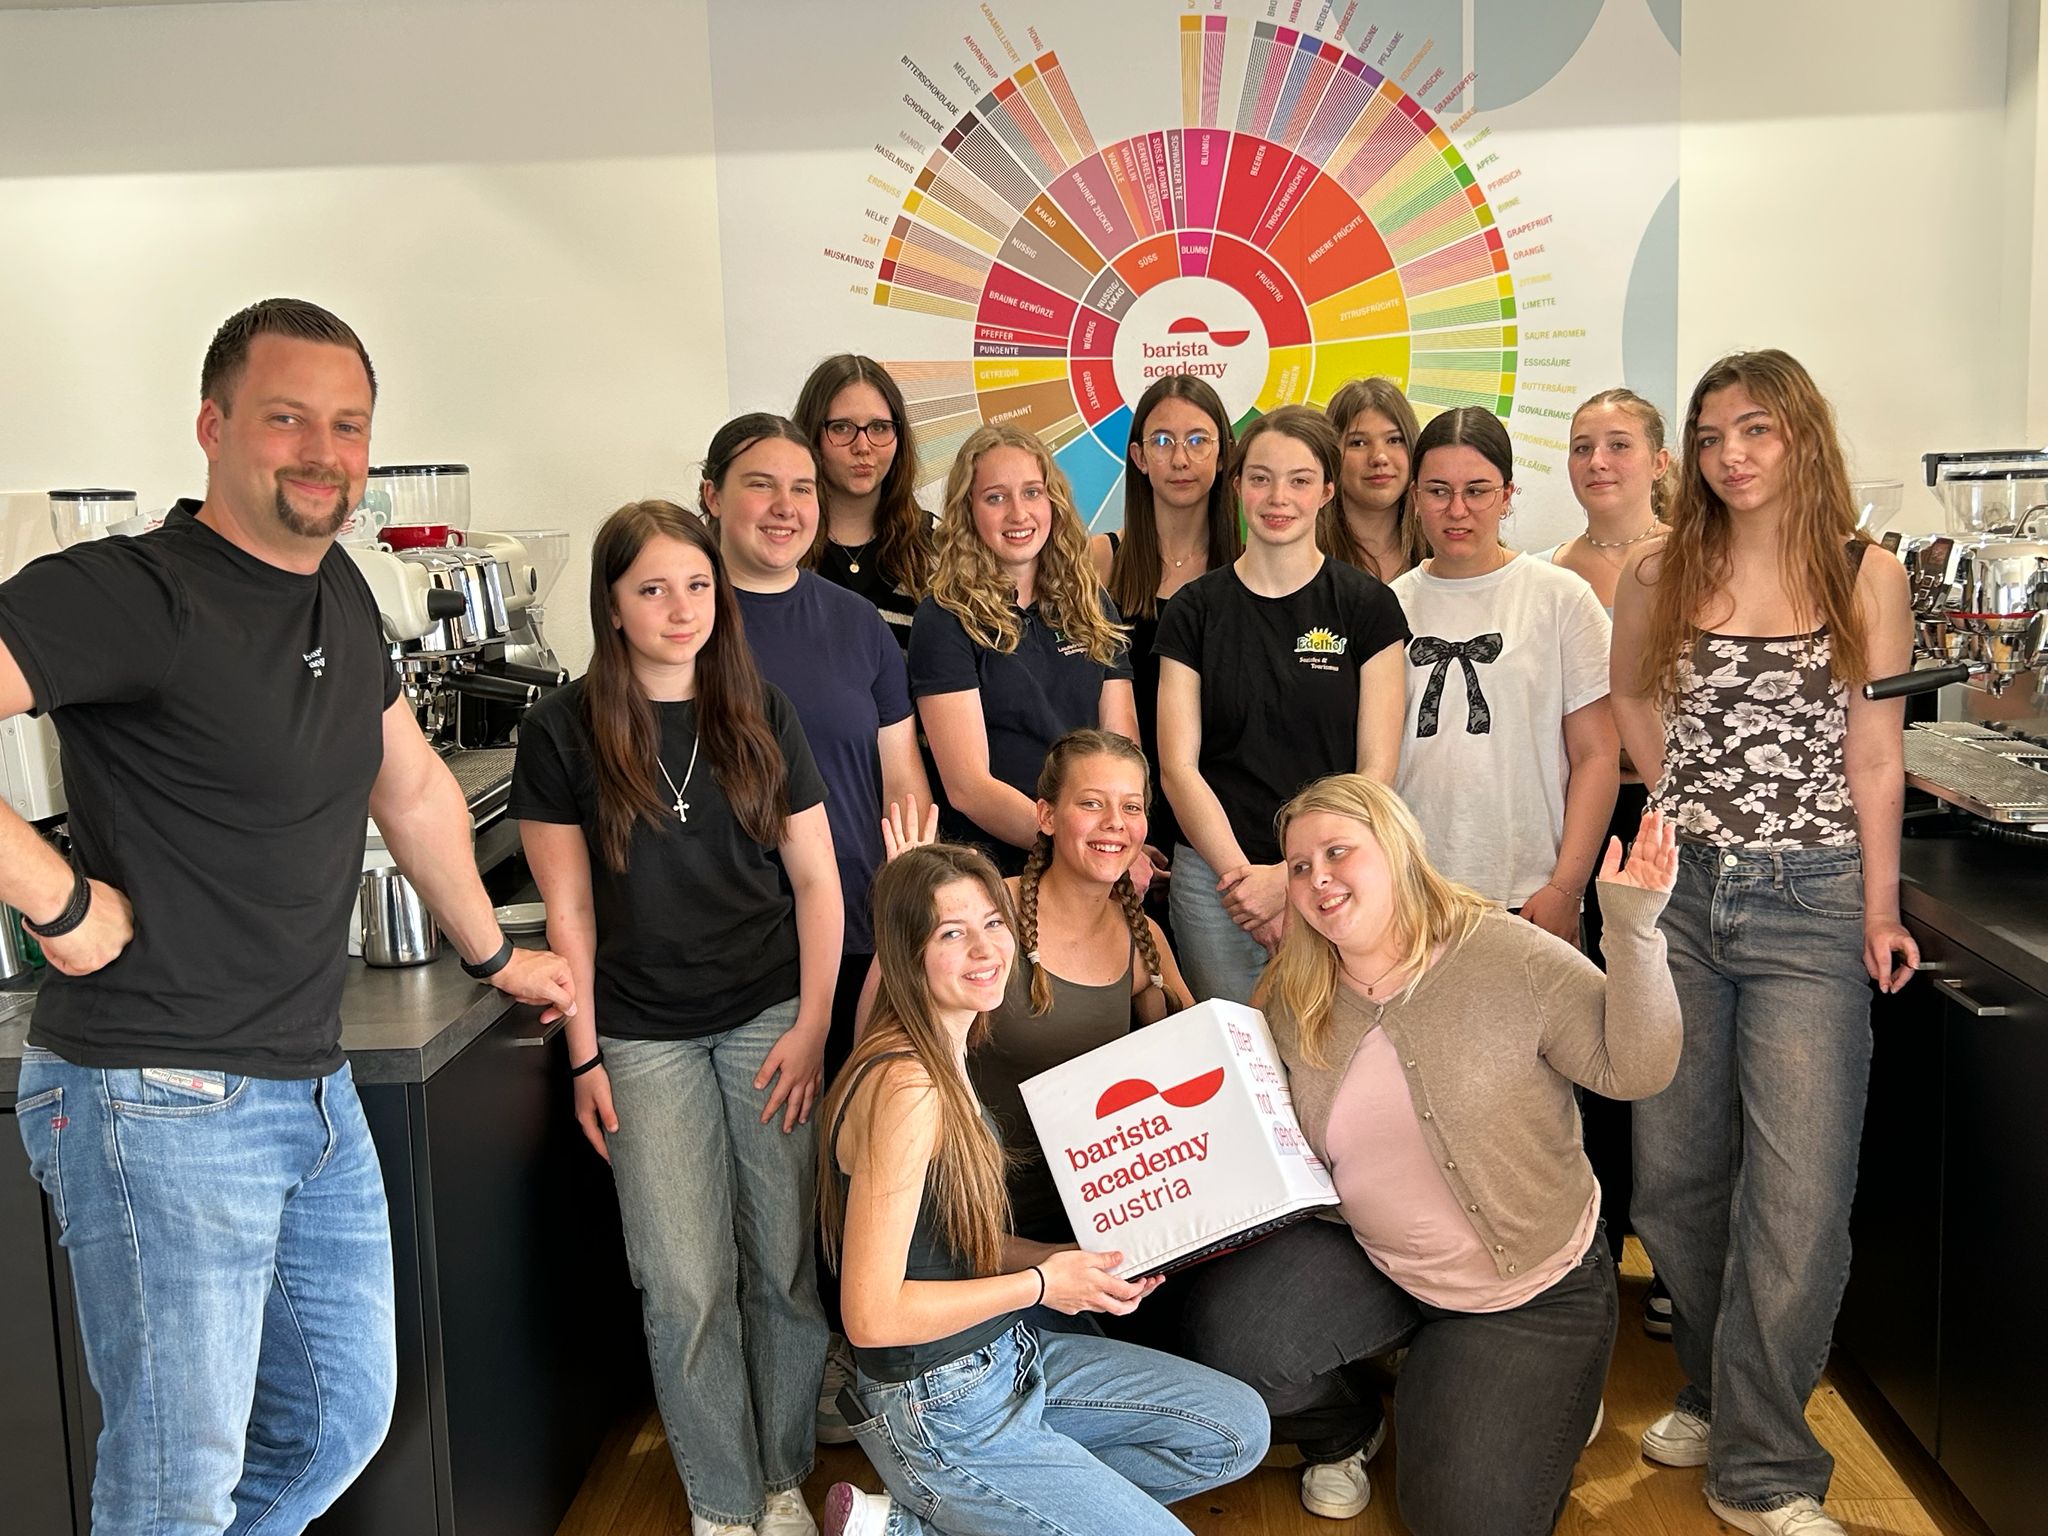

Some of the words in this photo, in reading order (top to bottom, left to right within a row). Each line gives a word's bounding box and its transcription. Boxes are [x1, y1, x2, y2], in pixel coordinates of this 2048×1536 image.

[1289, 0, 1302, 24] HIMB
[1027, 26, 1044, 51] HONIG
[1358, 24, 1379, 54] ROSINE
[1377, 31, 1404, 66] PFLAUME
[963, 35, 999, 79] AHORNSIRUP
[900, 55, 960, 117] BITTERSCHOKOLADE
[953, 62, 982, 96] MELASSE
[1416, 66, 1446, 98] KIRSCHE
[1433, 72, 1478, 115] GRANATAPFEL
[902, 94, 945, 134] SCHOKOLADE
[1449, 106, 1478, 133] ANANAS
[899, 130, 927, 156] MANDEL
[1152, 137, 1164, 164] SÜSSE
[1201, 134, 1210, 166] BLUMIG
[1463, 126, 1492, 151] TRAUBE
[874, 143, 915, 174] HASELNUSS
[1108, 152, 1125, 184] VANILLE
[1120, 146, 1138, 182] VANILLIN
[1136, 142, 1152, 182] GENERELL
[1170, 135, 1181, 184] SCHWARZER
[1250, 145, 1266, 177] BEEREN
[1476, 153, 1499, 171] APFEL
[1157, 166, 1169, 200] AROMEN
[1174, 184, 1183, 200] TEE
[1487, 168, 1522, 192] PFIRSICH
[1072, 172, 1097, 207] BRAUNER
[1092, 205, 1114, 234] ZUCKER
[1265, 164, 1308, 230] TROCKENFRÜCHTE
[864, 208, 889, 226] NELKE
[1034, 205, 1057, 228] KAKAO
[1506, 214, 1553, 239] GRAPEFRUIT
[862, 233, 882, 247] ZIMT
[1011, 237, 1038, 260] NUSSIG
[1181, 246, 1208, 255] BLUMIG
[1307, 239, 1334, 265] ANDERE
[1334, 215, 1364, 244] FRÜCHTE
[1513, 244, 1545, 260] ORANGE
[824, 248, 875, 270] MUSKATNUSS
[1137, 252, 1158, 269] SÜSS
[850, 284, 869, 296] ANIS
[1105, 287, 1125, 312] KAKAO
[1255, 269, 1284, 304] FRUCHTIG
[988, 290, 1018, 307] BRAUNE
[1020, 300, 1055, 319] GEWÜRZE
[1340, 297, 1400, 322] ZITRUSFRÜCHTE
[1522, 297, 1556, 310] LIMETTE
[980, 328, 1014, 341] PFEFFER
[1083, 320, 1096, 350] WÜRZIG
[1552, 329, 1586, 339] AROMEN
[1142, 342, 1209, 359] barista
[1143, 361, 1228, 380] academy
[1082, 370, 1101, 410] GERÖSTET
[989, 404, 1033, 425] VERBRANNT
[1518, 404, 1572, 421] ISOVALERIANS
[1513, 456, 1552, 474] FELSÄURE
[1297, 637, 1347, 654] Edelhof
[1065, 1114, 1172, 1172] barista
[1080, 1131, 1211, 1203] academy
[1092, 1177, 1193, 1234] austria
